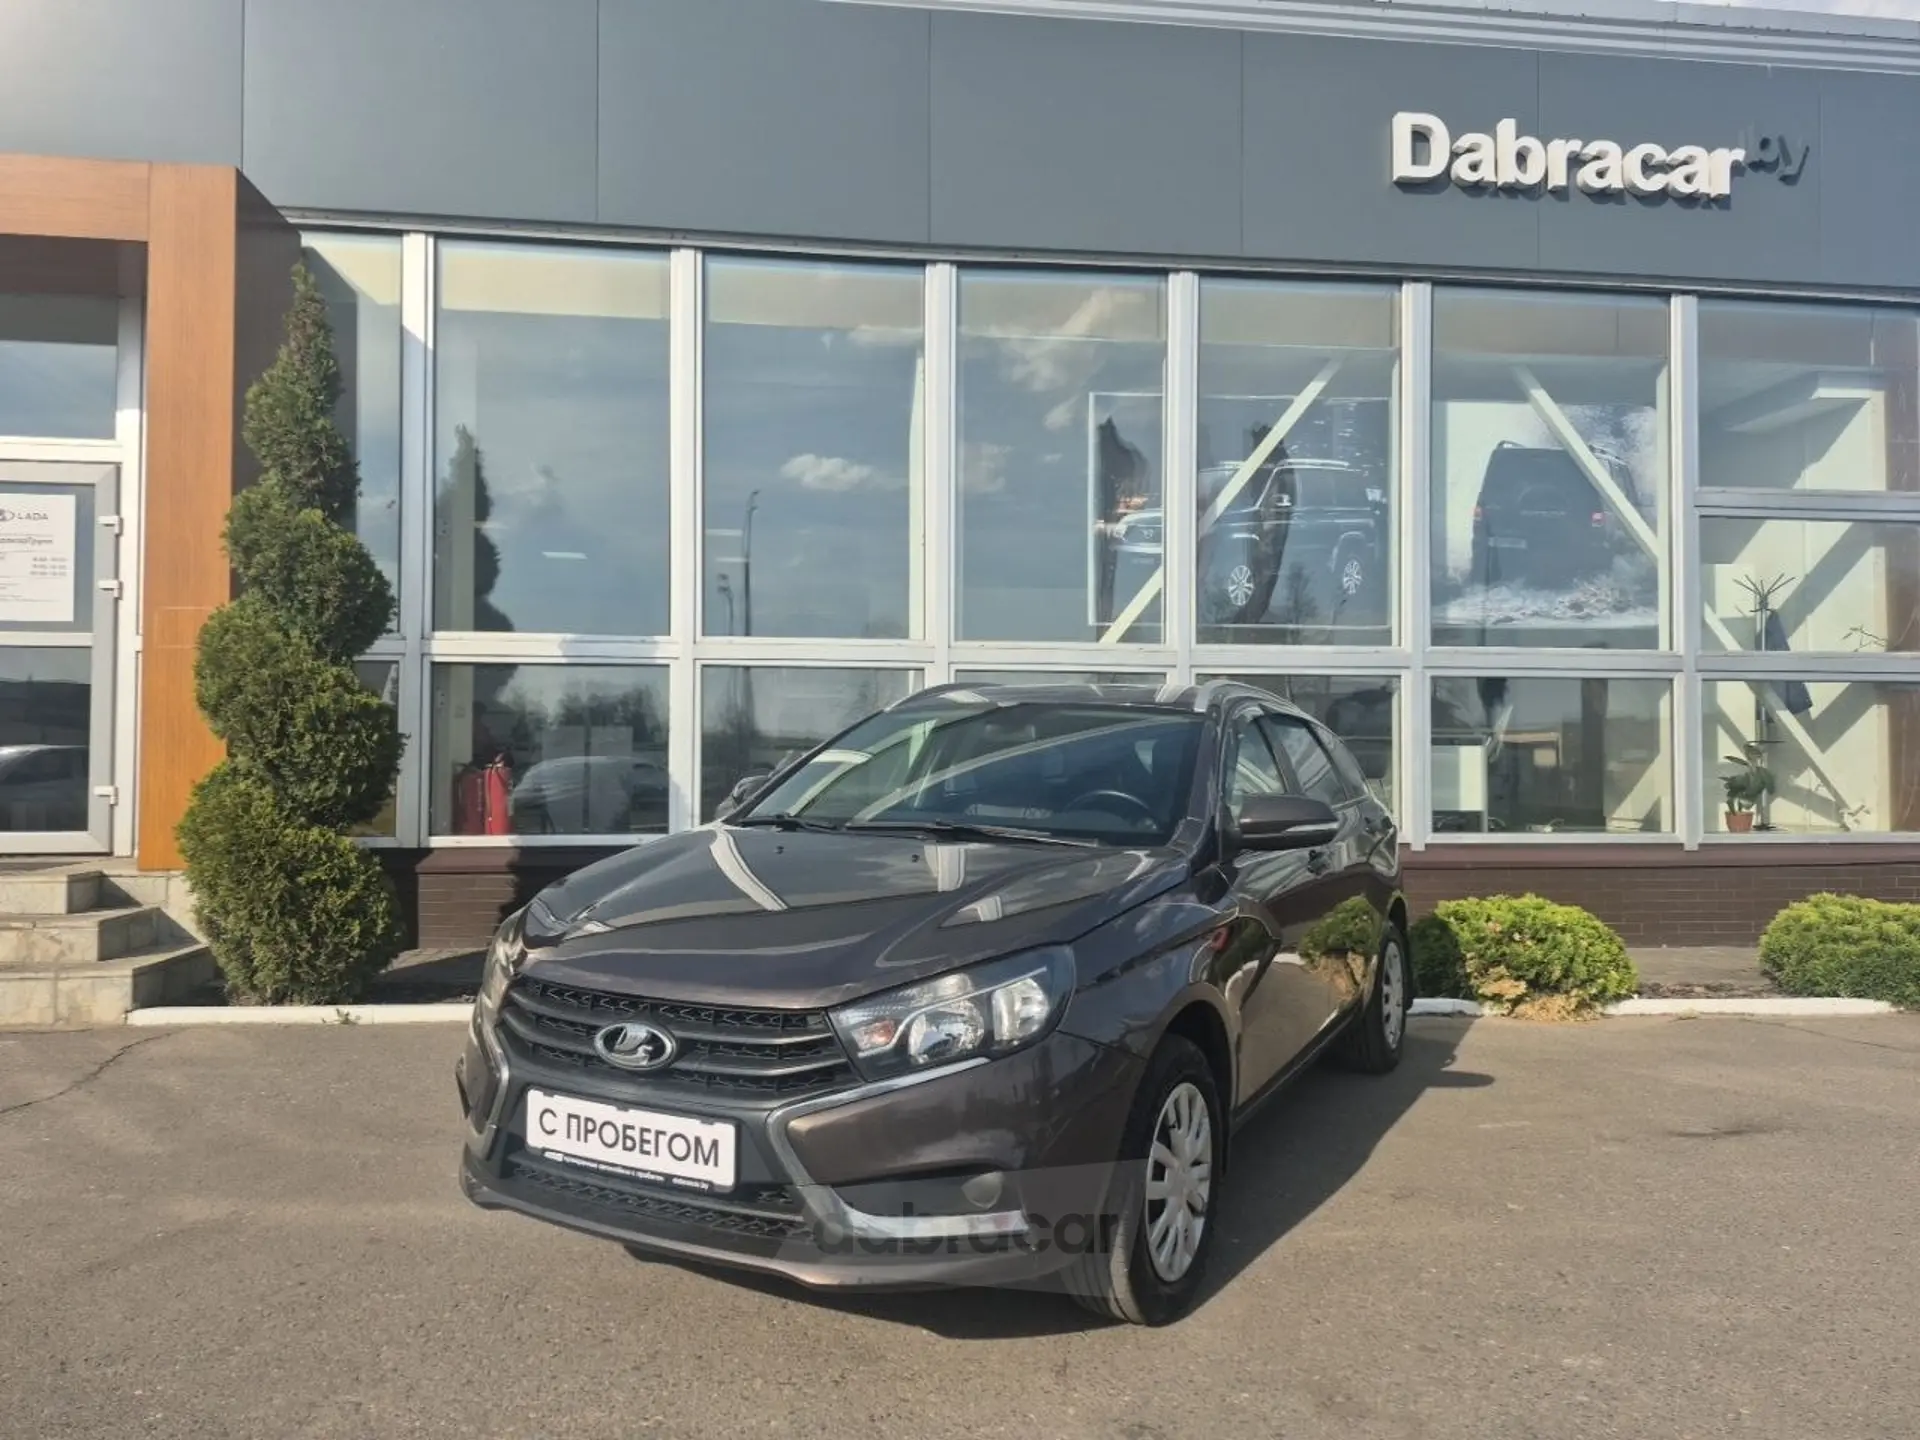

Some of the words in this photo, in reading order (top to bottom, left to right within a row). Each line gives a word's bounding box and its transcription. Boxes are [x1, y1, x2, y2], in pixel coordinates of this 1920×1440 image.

[1392, 112, 1746, 199] Dabracar
[17, 512, 49, 520] LADA
[539, 1108, 558, 1136] С
[566, 1112, 720, 1168] ПРОБЕГОМ
